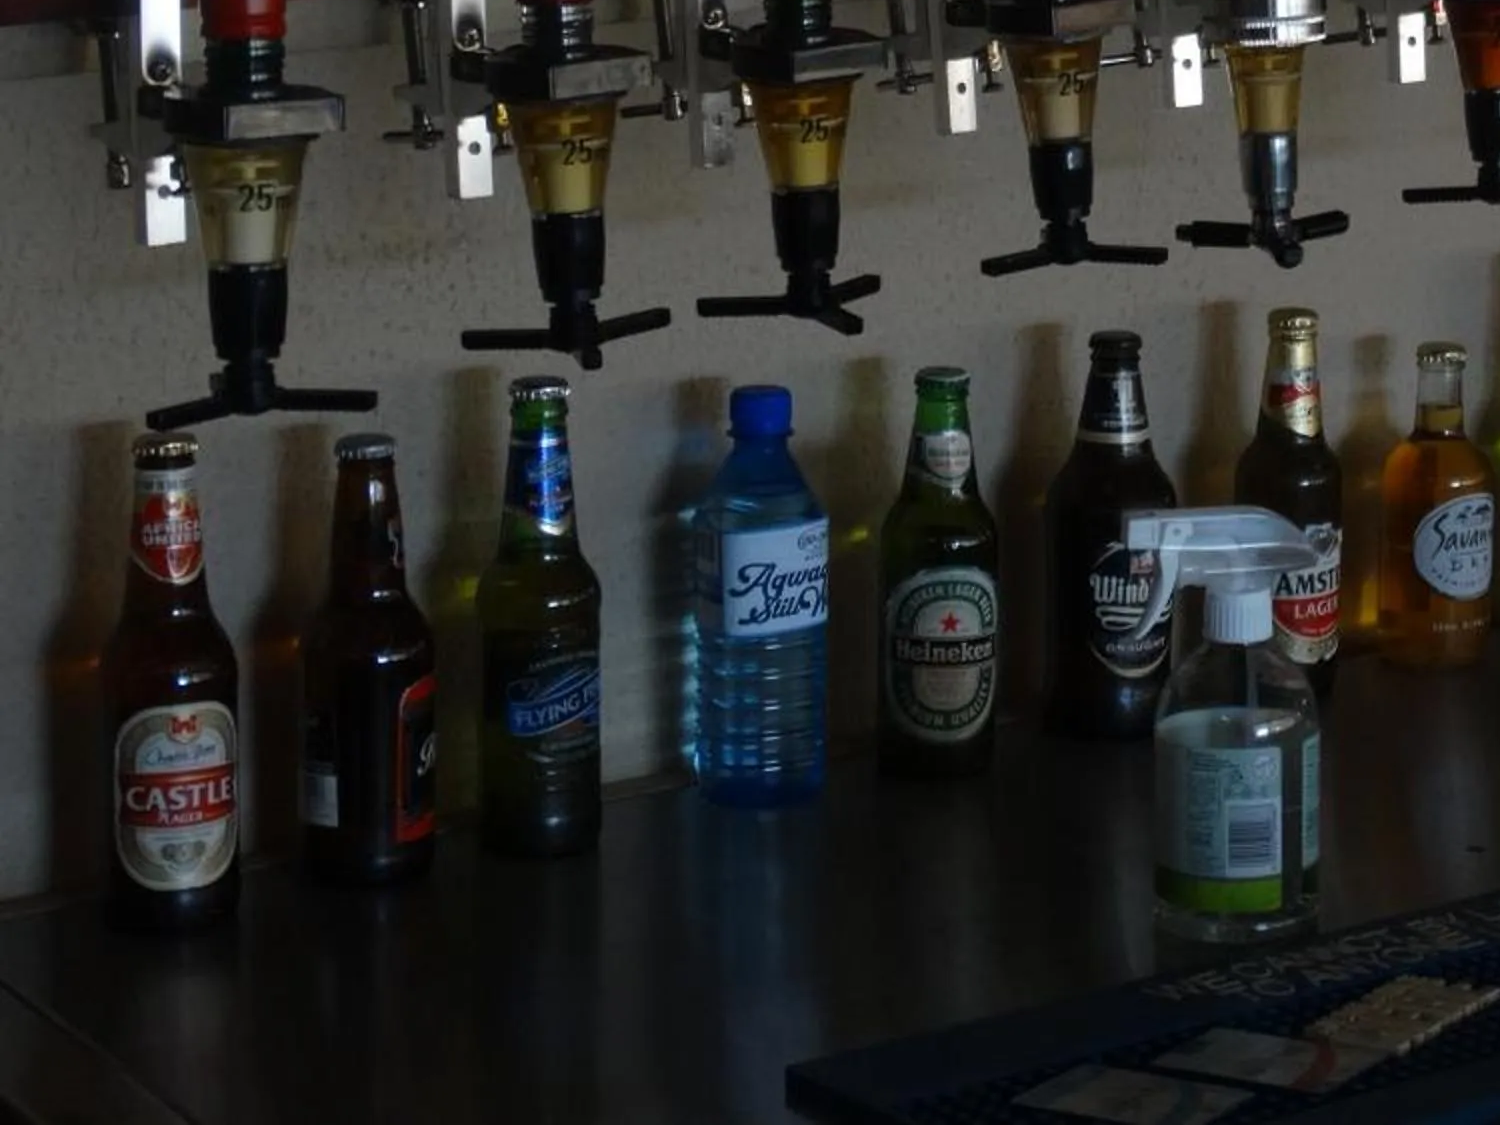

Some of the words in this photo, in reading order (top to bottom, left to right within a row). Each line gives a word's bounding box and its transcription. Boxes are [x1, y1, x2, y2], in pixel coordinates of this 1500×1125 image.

[1058, 70, 1085, 96] 25
[800, 116, 829, 144] 25
[562, 137, 593, 166] 25
[239, 183, 274, 212] 25
[895, 633, 993, 665] Heineken
[515, 691, 581, 727] FLYING
[125, 776, 233, 813] CASTLE
